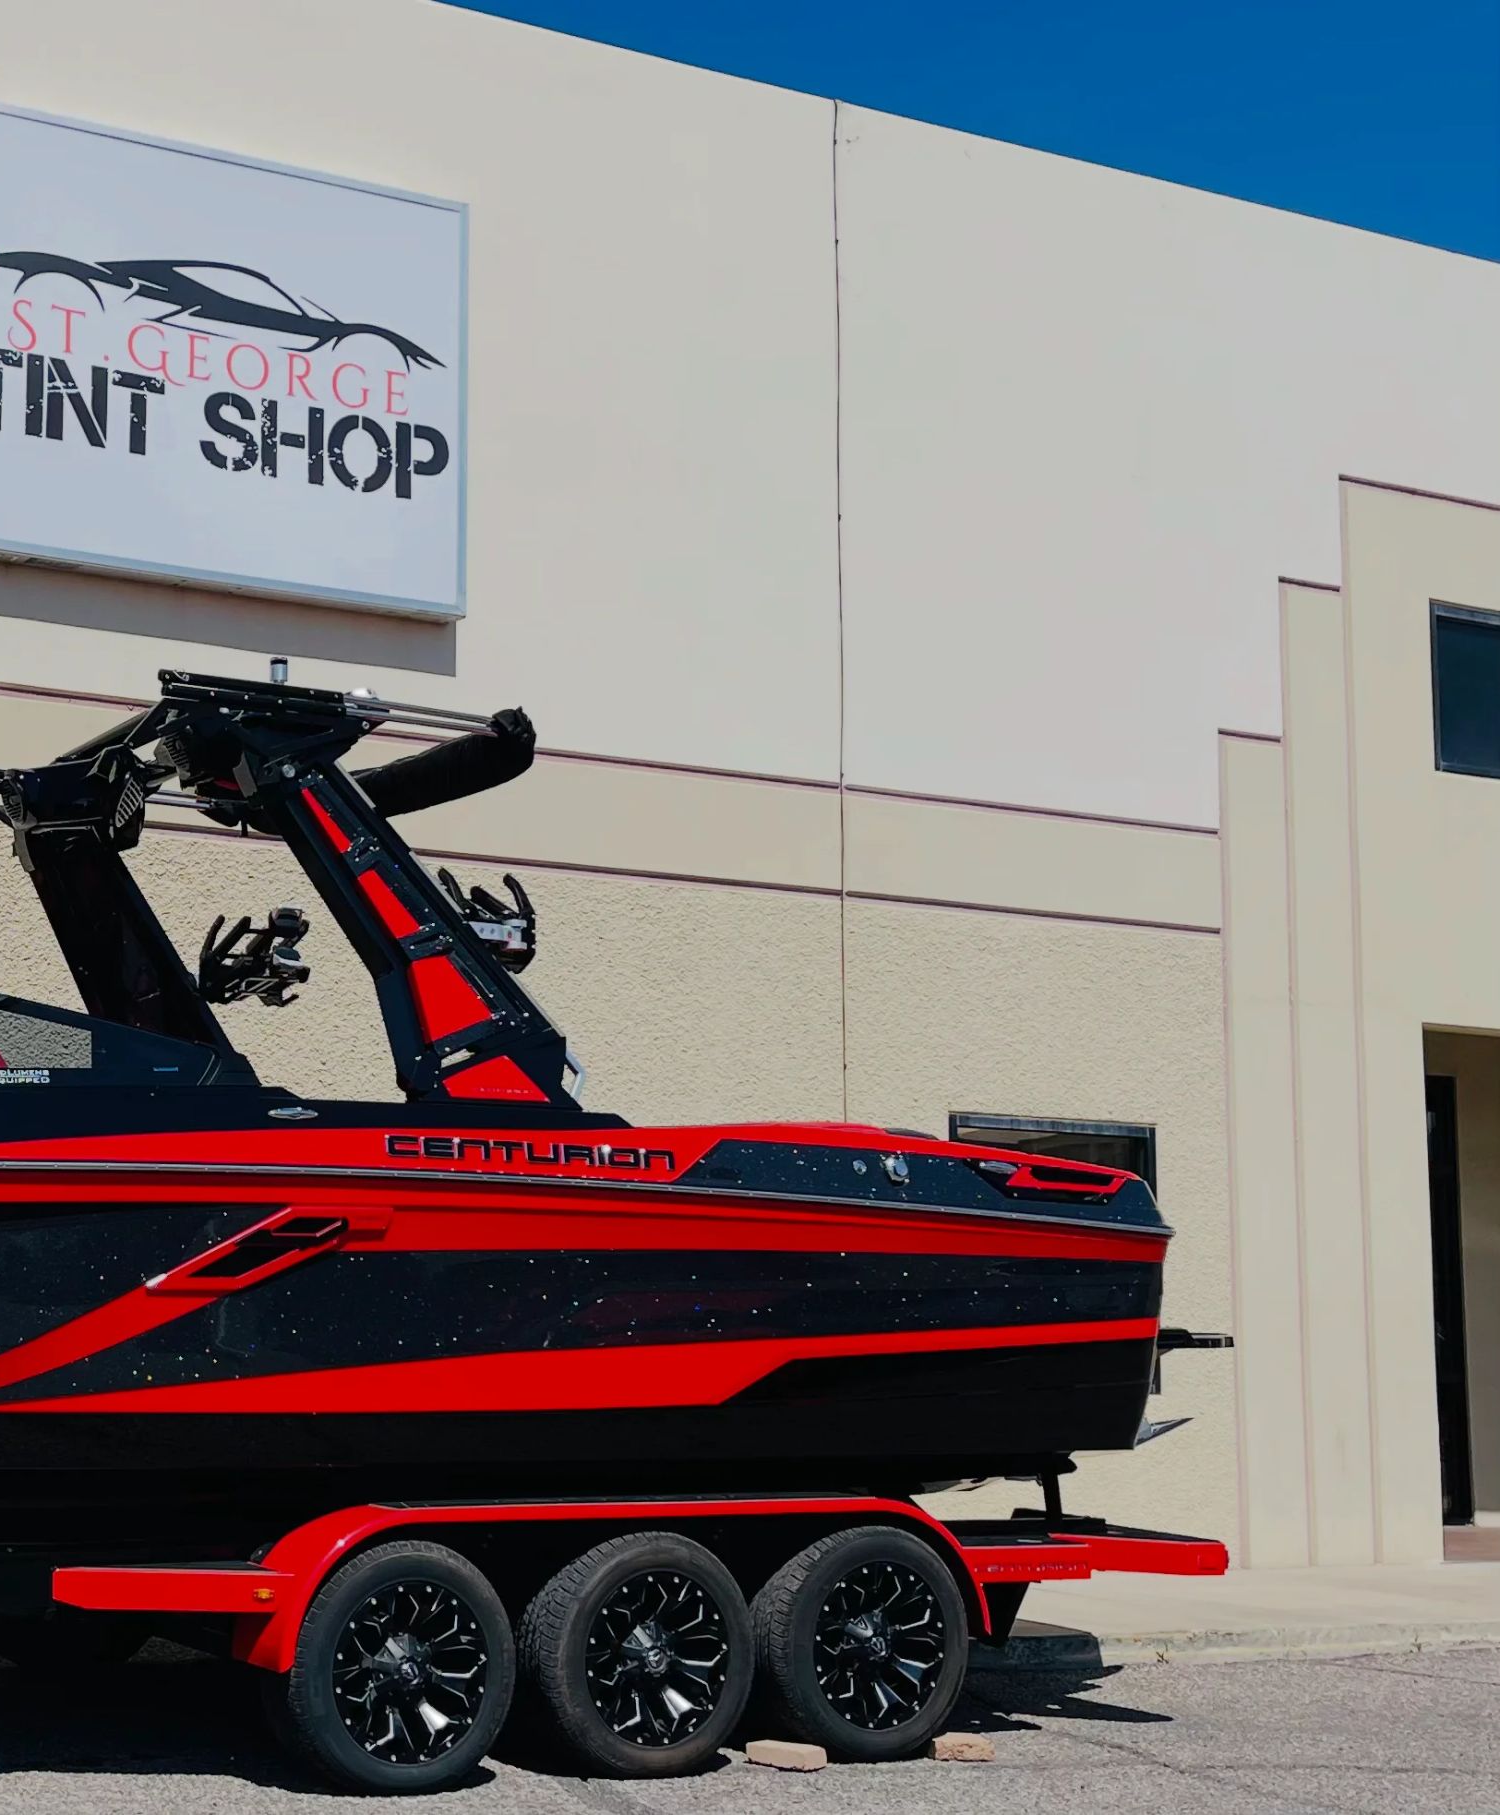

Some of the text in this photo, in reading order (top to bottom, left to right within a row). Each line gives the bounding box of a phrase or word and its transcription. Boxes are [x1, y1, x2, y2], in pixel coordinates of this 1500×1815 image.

[127, 324, 409, 416] GEORGE
[199, 391, 450, 500] SHOP
[384, 1134, 675, 1171] CENTURION
